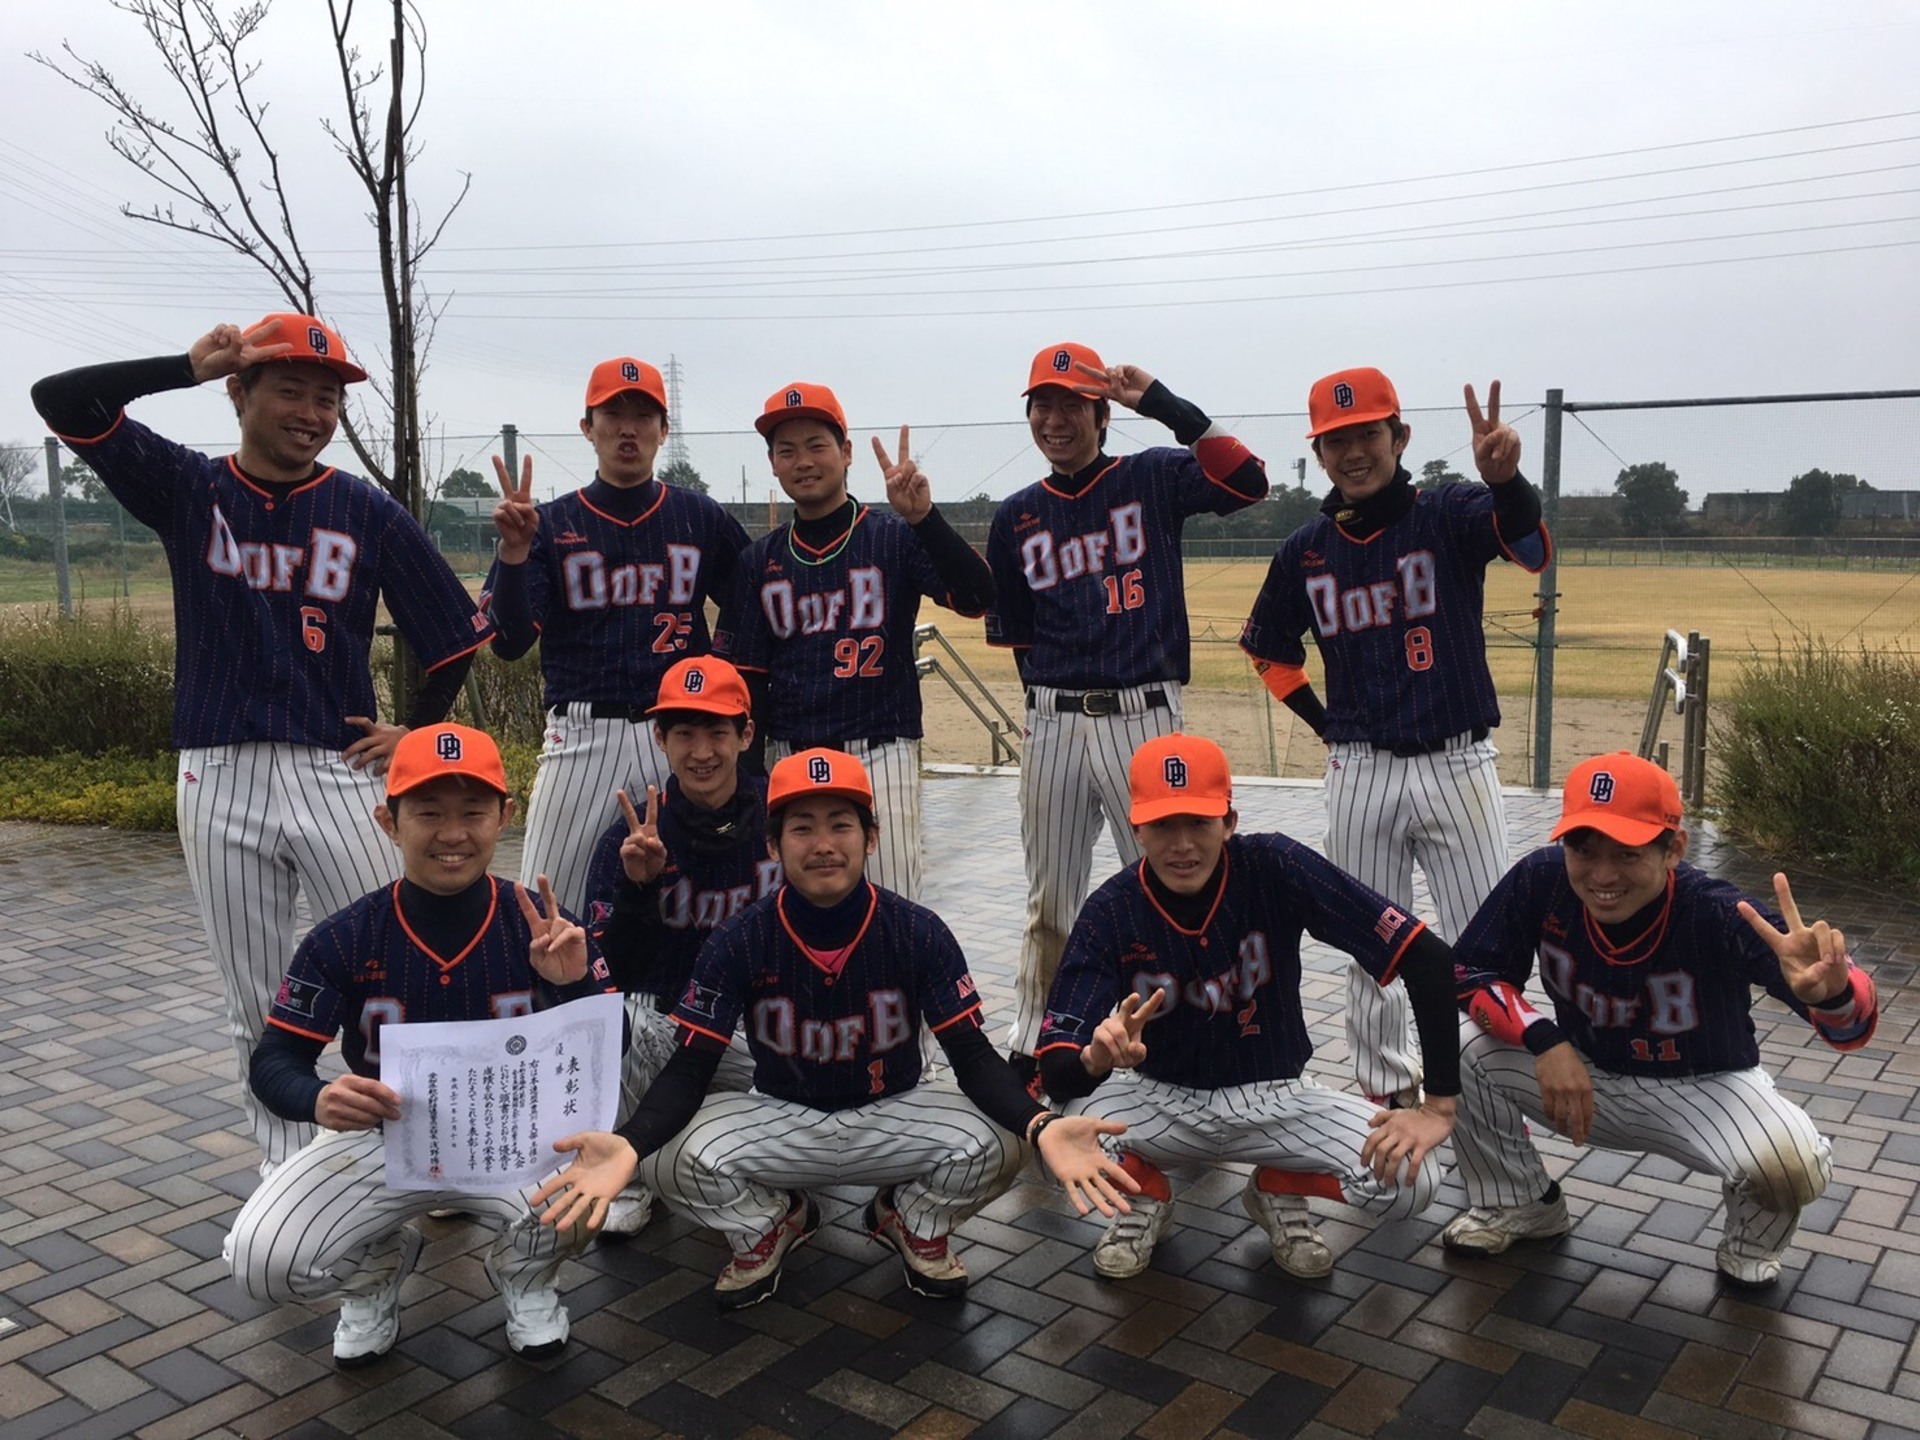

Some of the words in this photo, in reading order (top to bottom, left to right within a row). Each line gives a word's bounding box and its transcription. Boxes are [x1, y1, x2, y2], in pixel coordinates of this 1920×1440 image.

[1102, 568, 1146, 615] 16
[300, 605, 327, 653] 6
[652, 612, 693, 654] 25
[1404, 625, 1434, 672] 8
[833, 635, 885, 679] 92
[1237, 999, 1261, 1038] 2
[1630, 1038, 1681, 1061] 11
[563, 1056, 581, 1117] 表彰状
[867, 1059, 885, 1095] 1
